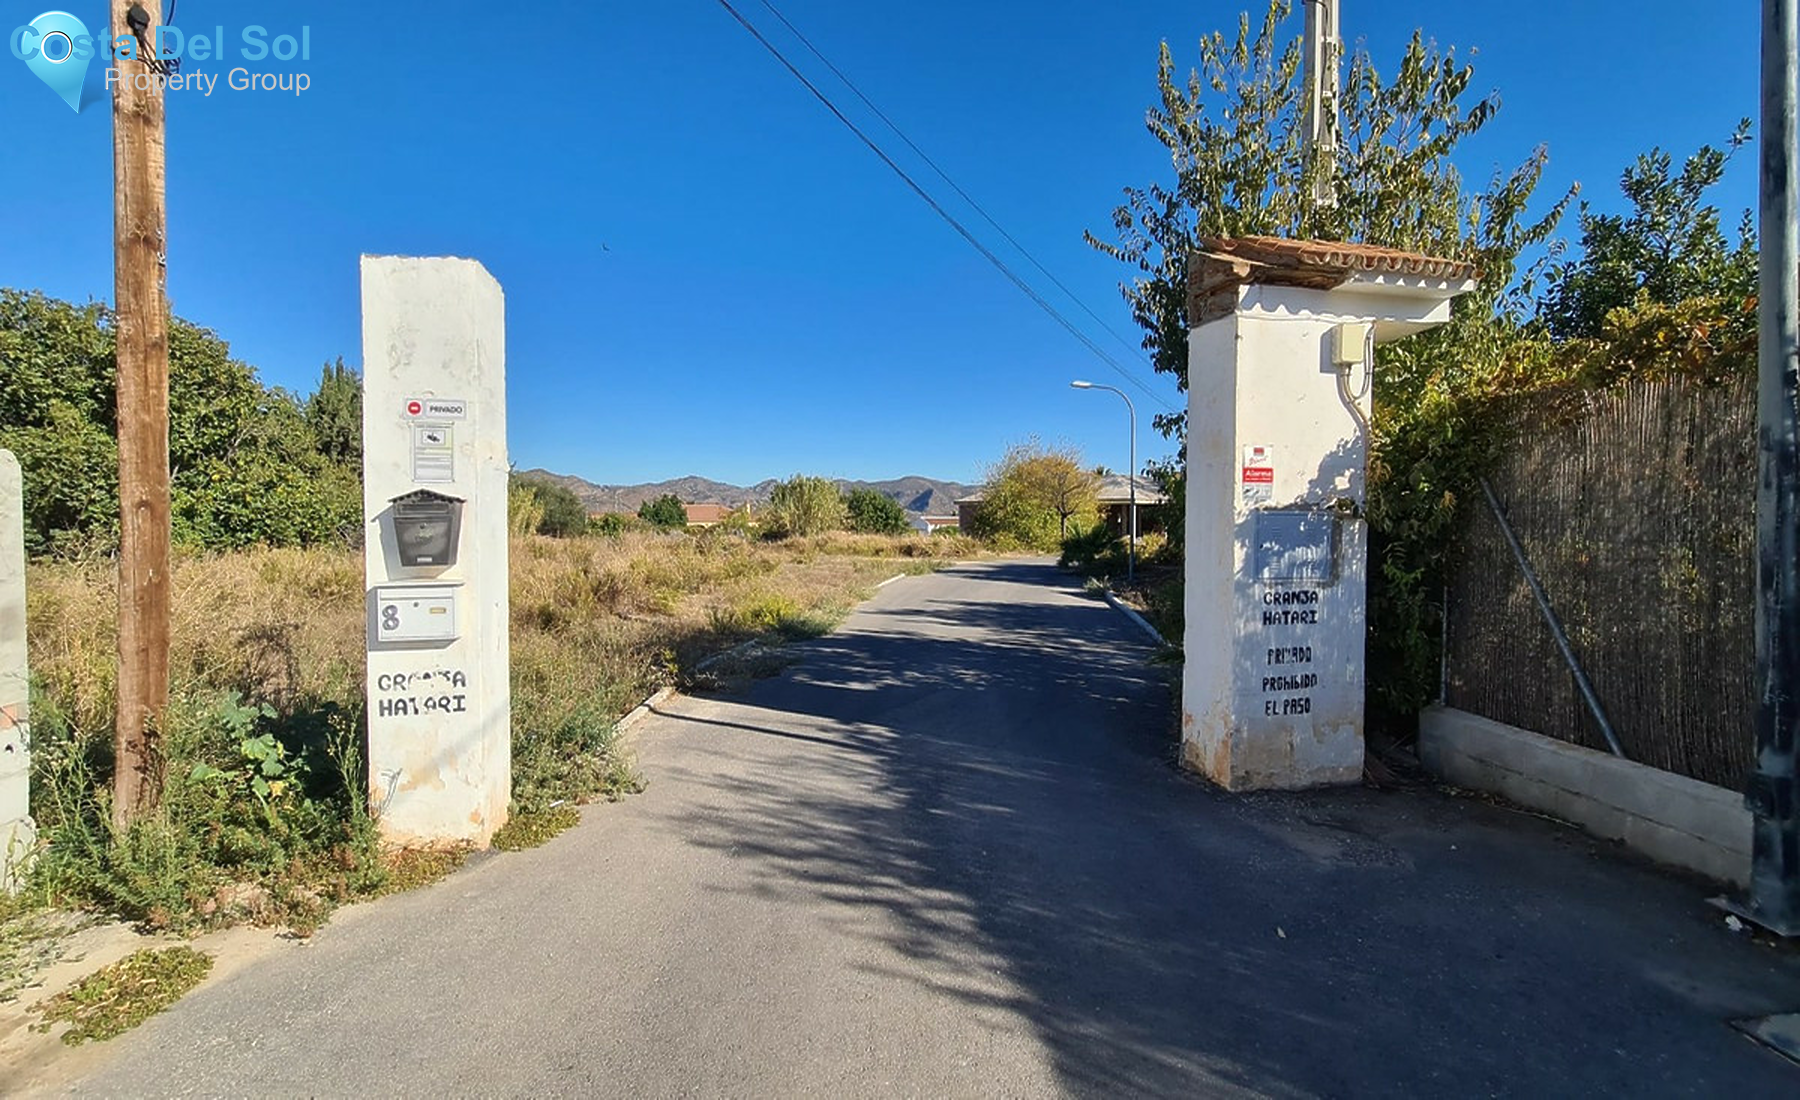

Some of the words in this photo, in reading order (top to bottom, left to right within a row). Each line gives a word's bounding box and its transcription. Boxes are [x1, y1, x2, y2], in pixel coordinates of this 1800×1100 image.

[429, 405, 463, 414] PRIVADO
[1263, 589, 1318, 606] GRANJA
[382, 604, 400, 631] 8
[1262, 609, 1318, 626] HATARI
[378, 670, 467, 691] GRA
[1265, 700, 1280, 717] EL
[1283, 697, 1311, 716] PASO
